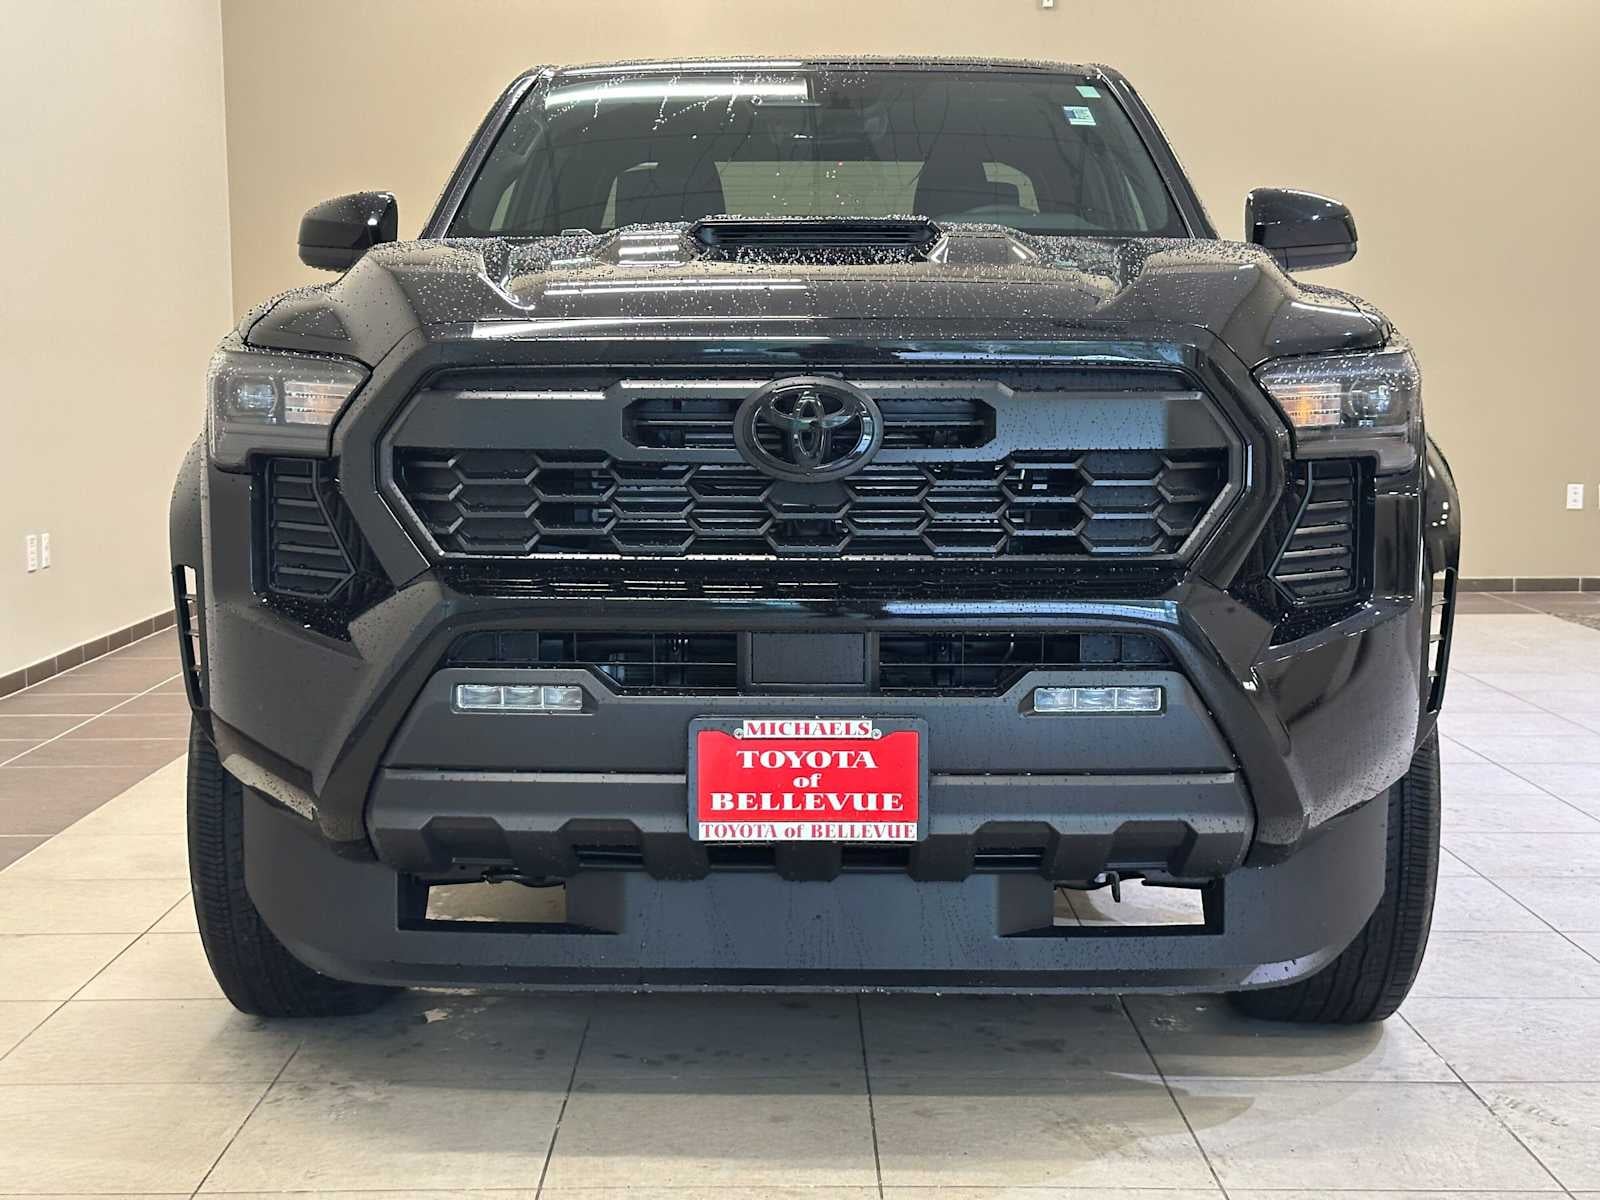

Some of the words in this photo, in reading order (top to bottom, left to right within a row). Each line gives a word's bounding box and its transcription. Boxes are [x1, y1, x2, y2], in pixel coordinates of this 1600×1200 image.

[746, 722, 871, 737] MICHAELS
[736, 750, 879, 769] TOYOTA
[792, 773, 822, 789] of
[710, 792, 904, 812] BELLEVUE
[701, 823, 777, 839] TOYOTA
[784, 823, 804, 839] of
[811, 823, 916, 839] BELLEVUE
